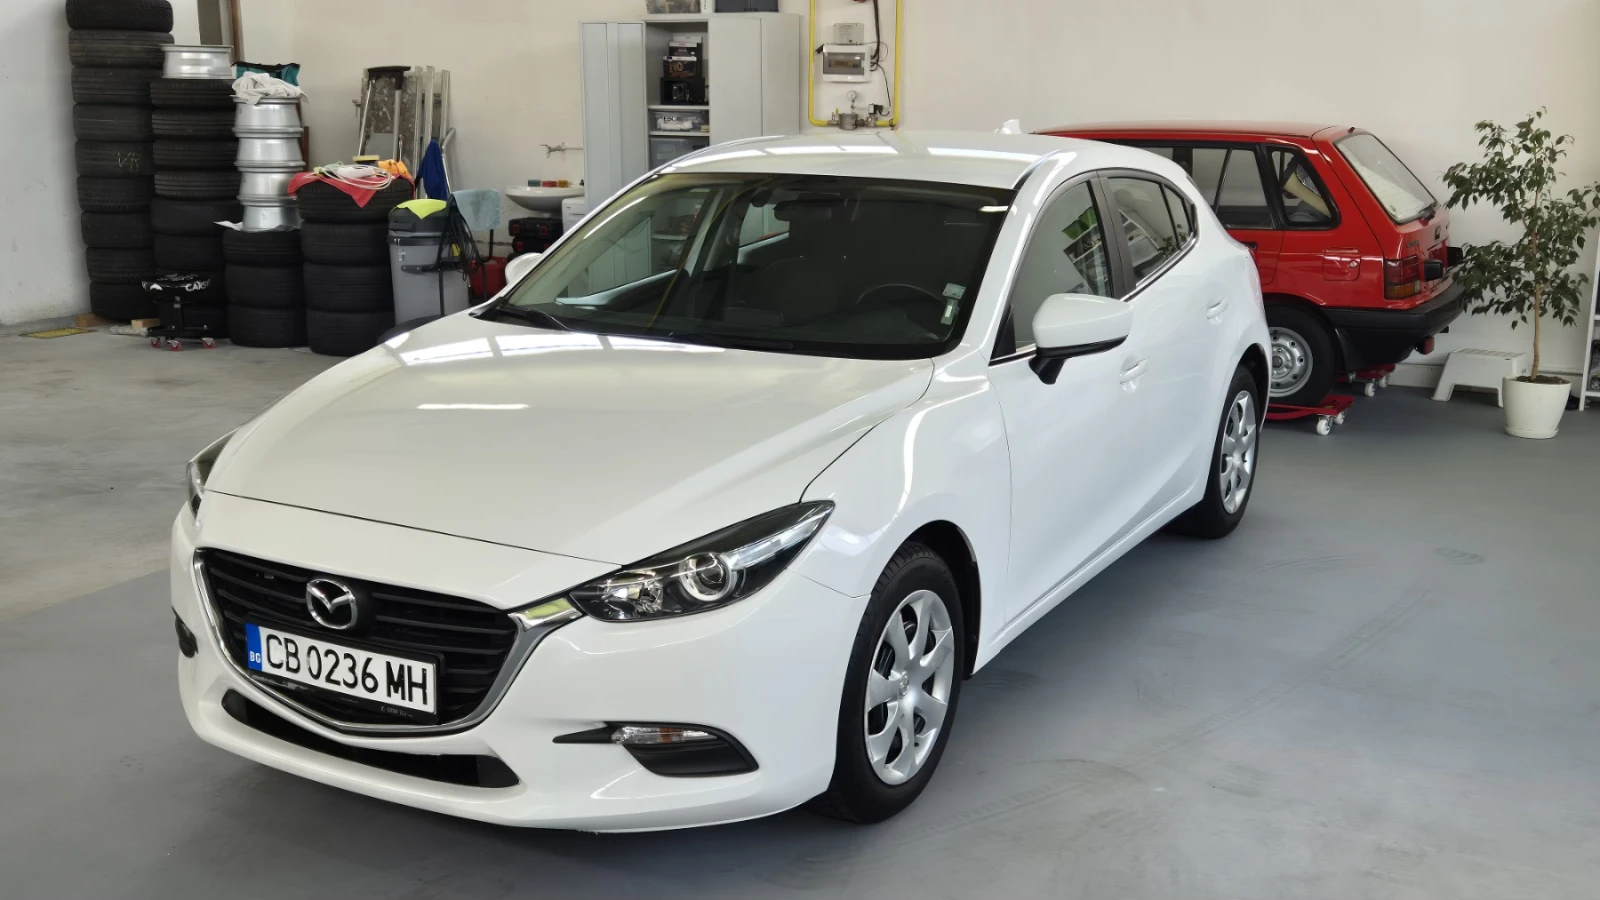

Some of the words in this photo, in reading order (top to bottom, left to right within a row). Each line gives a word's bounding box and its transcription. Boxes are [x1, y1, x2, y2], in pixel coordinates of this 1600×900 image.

[249, 650, 262, 664] BG
[266, 633, 301, 674] CB
[306, 644, 379, 694] 0236
[386, 660, 428, 705] MH
